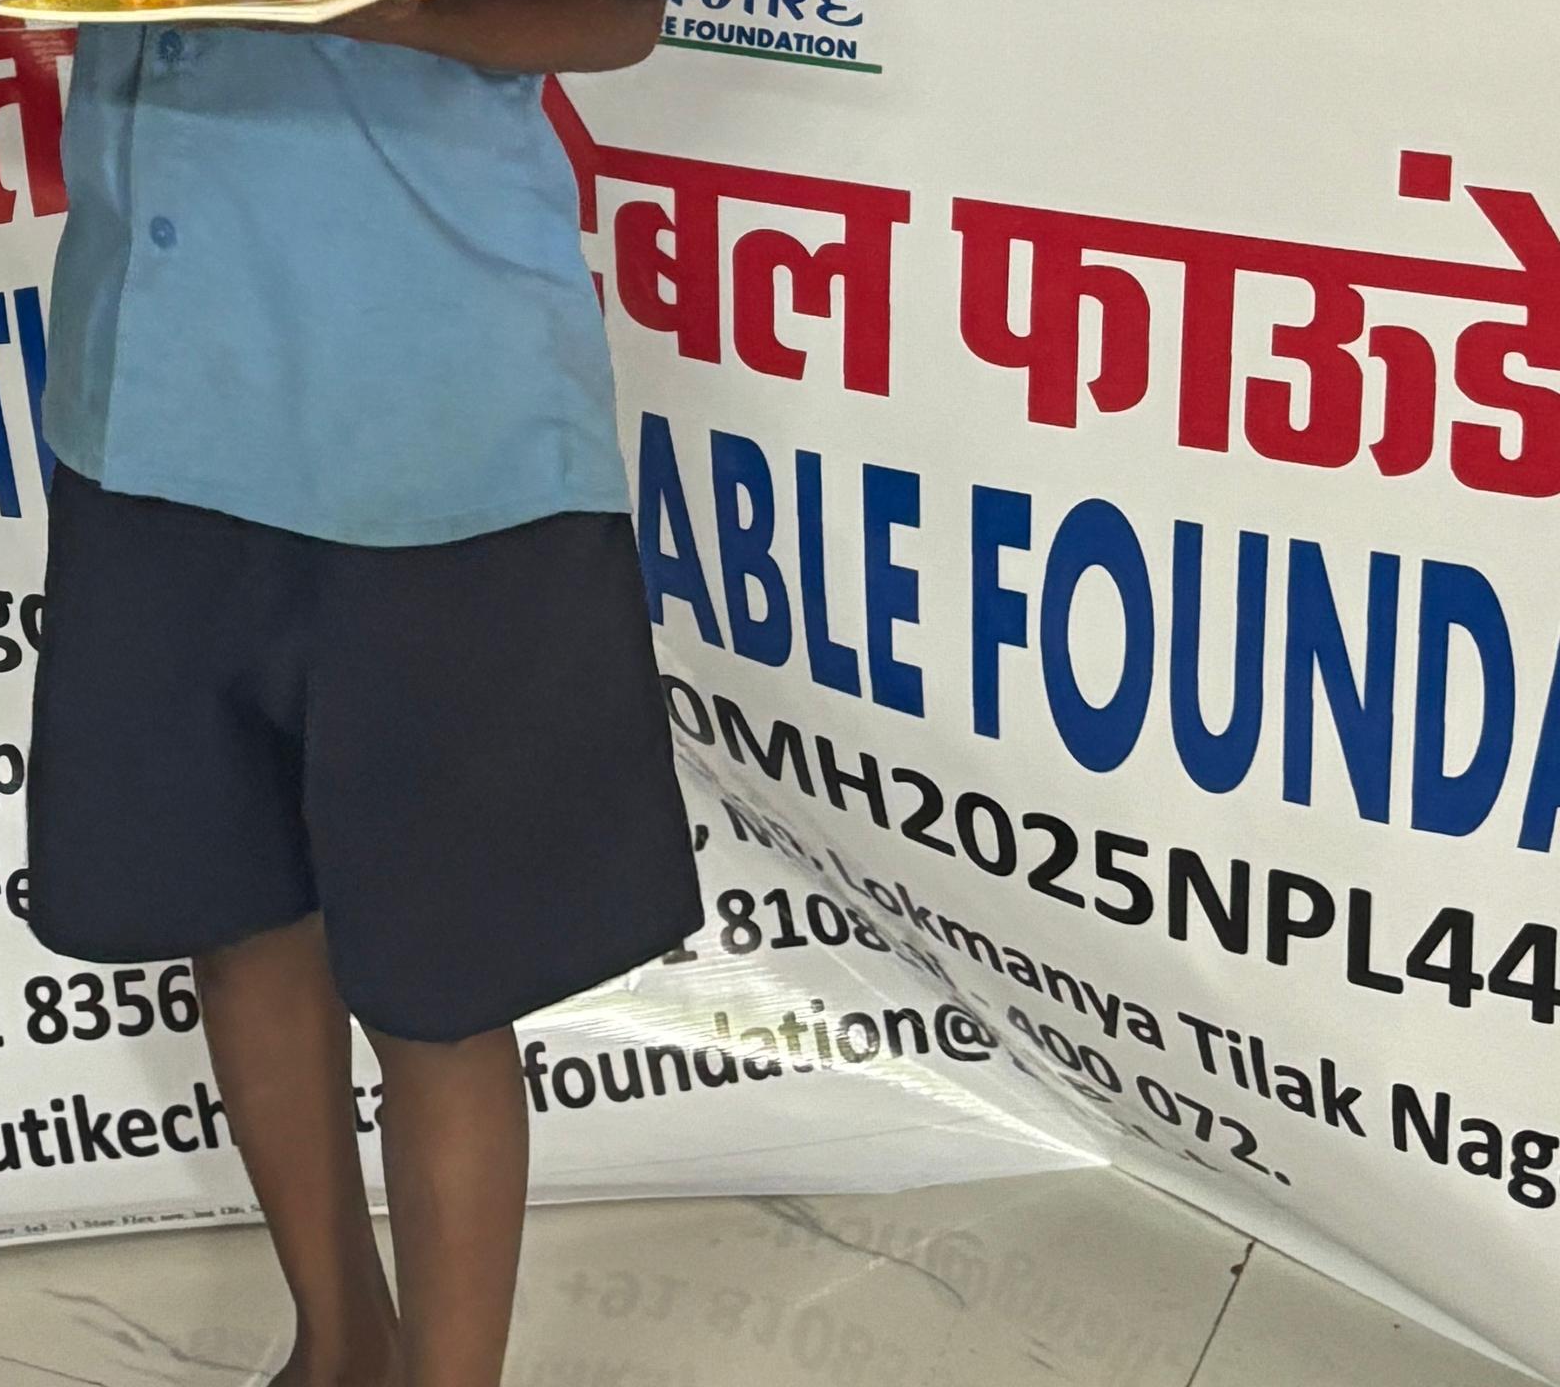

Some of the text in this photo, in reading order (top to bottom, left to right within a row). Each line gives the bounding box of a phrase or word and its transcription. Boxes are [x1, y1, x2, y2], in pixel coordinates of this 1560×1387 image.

[683, 18, 857, 59] FOUNDATION
[951, 150, 1560, 498] फाऊंडे
[641, 412, 925, 719] ABLE
[972, 485, 1560, 853] FOUND
[25, 964, 200, 1045] 8356
[521, 998, 999, 1113] foundation@
[1178, 1011, 1366, 1137] Tilak
[1391, 1083, 1560, 1209] Nag
